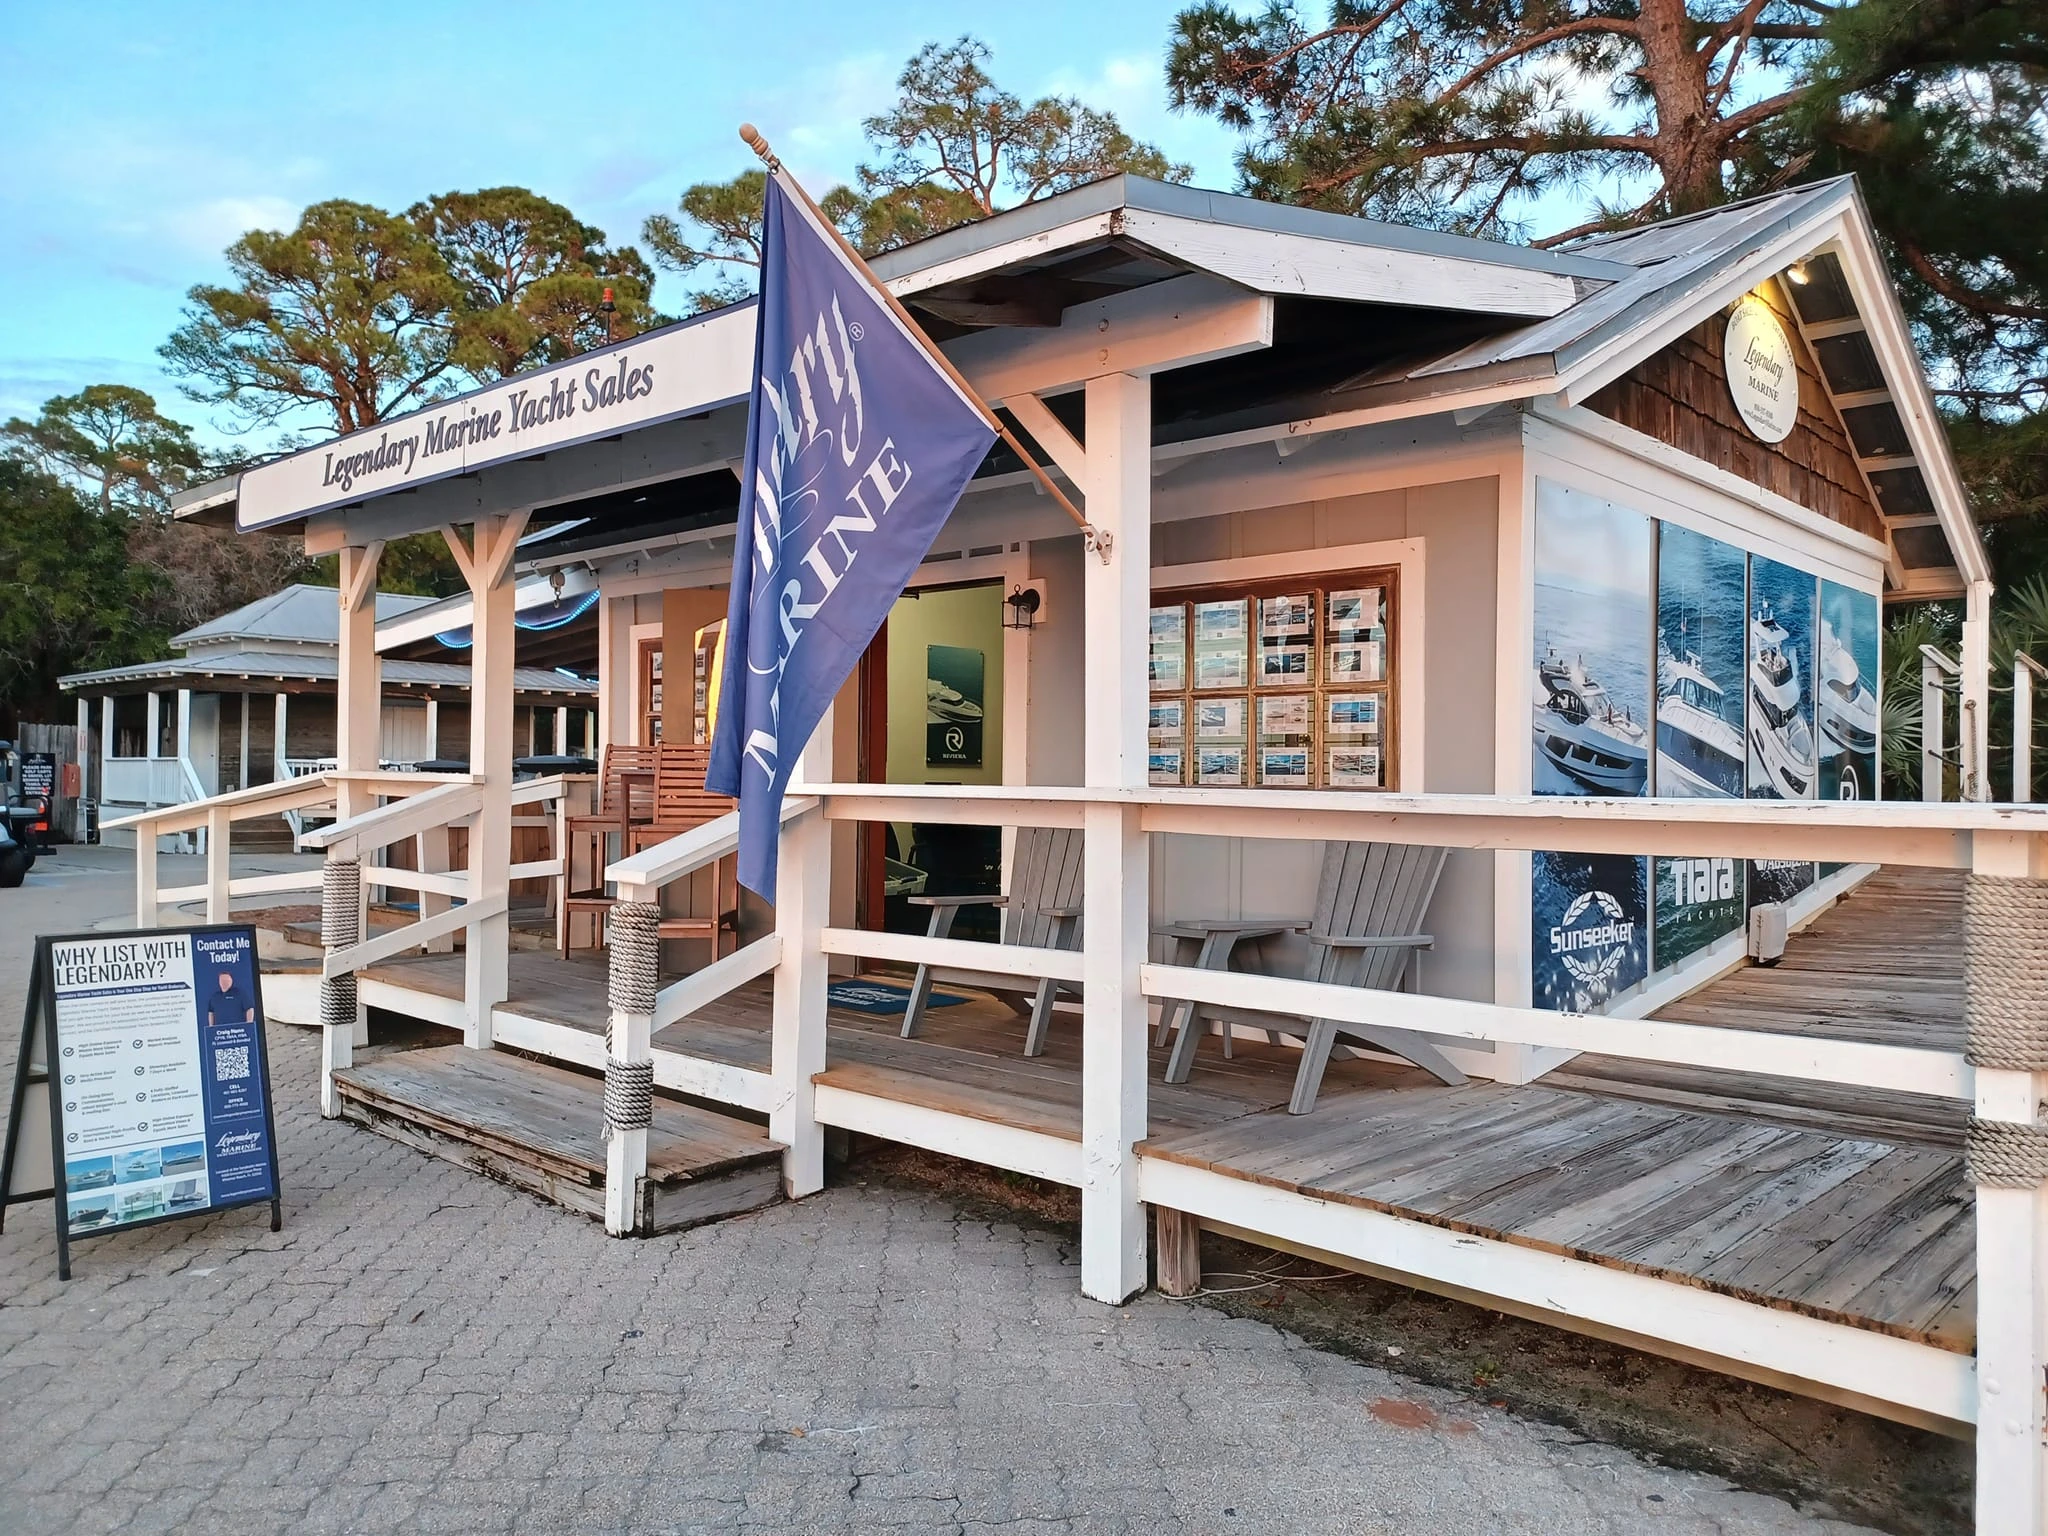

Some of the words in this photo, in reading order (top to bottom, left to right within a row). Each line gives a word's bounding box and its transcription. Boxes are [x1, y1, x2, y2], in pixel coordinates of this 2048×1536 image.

[1744, 336, 1784, 388] Legendary
[1748, 375, 1780, 402] MARINE
[322, 433, 419, 492] Legendary
[422, 407, 502, 458] Marine
[508, 377, 577, 433] Yacht
[581, 355, 654, 413] Sales
[1676, 906, 1734, 924] YACHTS
[197, 939, 234, 951] Contact
[236, 937, 250, 949] Me
[1550, 919, 1634, 954] Sunseeker
[55, 946, 97, 967] WHY
[103, 944, 138, 964] LIST
[143, 941, 186, 961] WITH
[209, 950, 240, 964] Today!
[56, 960, 167, 986] LEGENDARY?
[221, 1143, 257, 1153] MARINE
